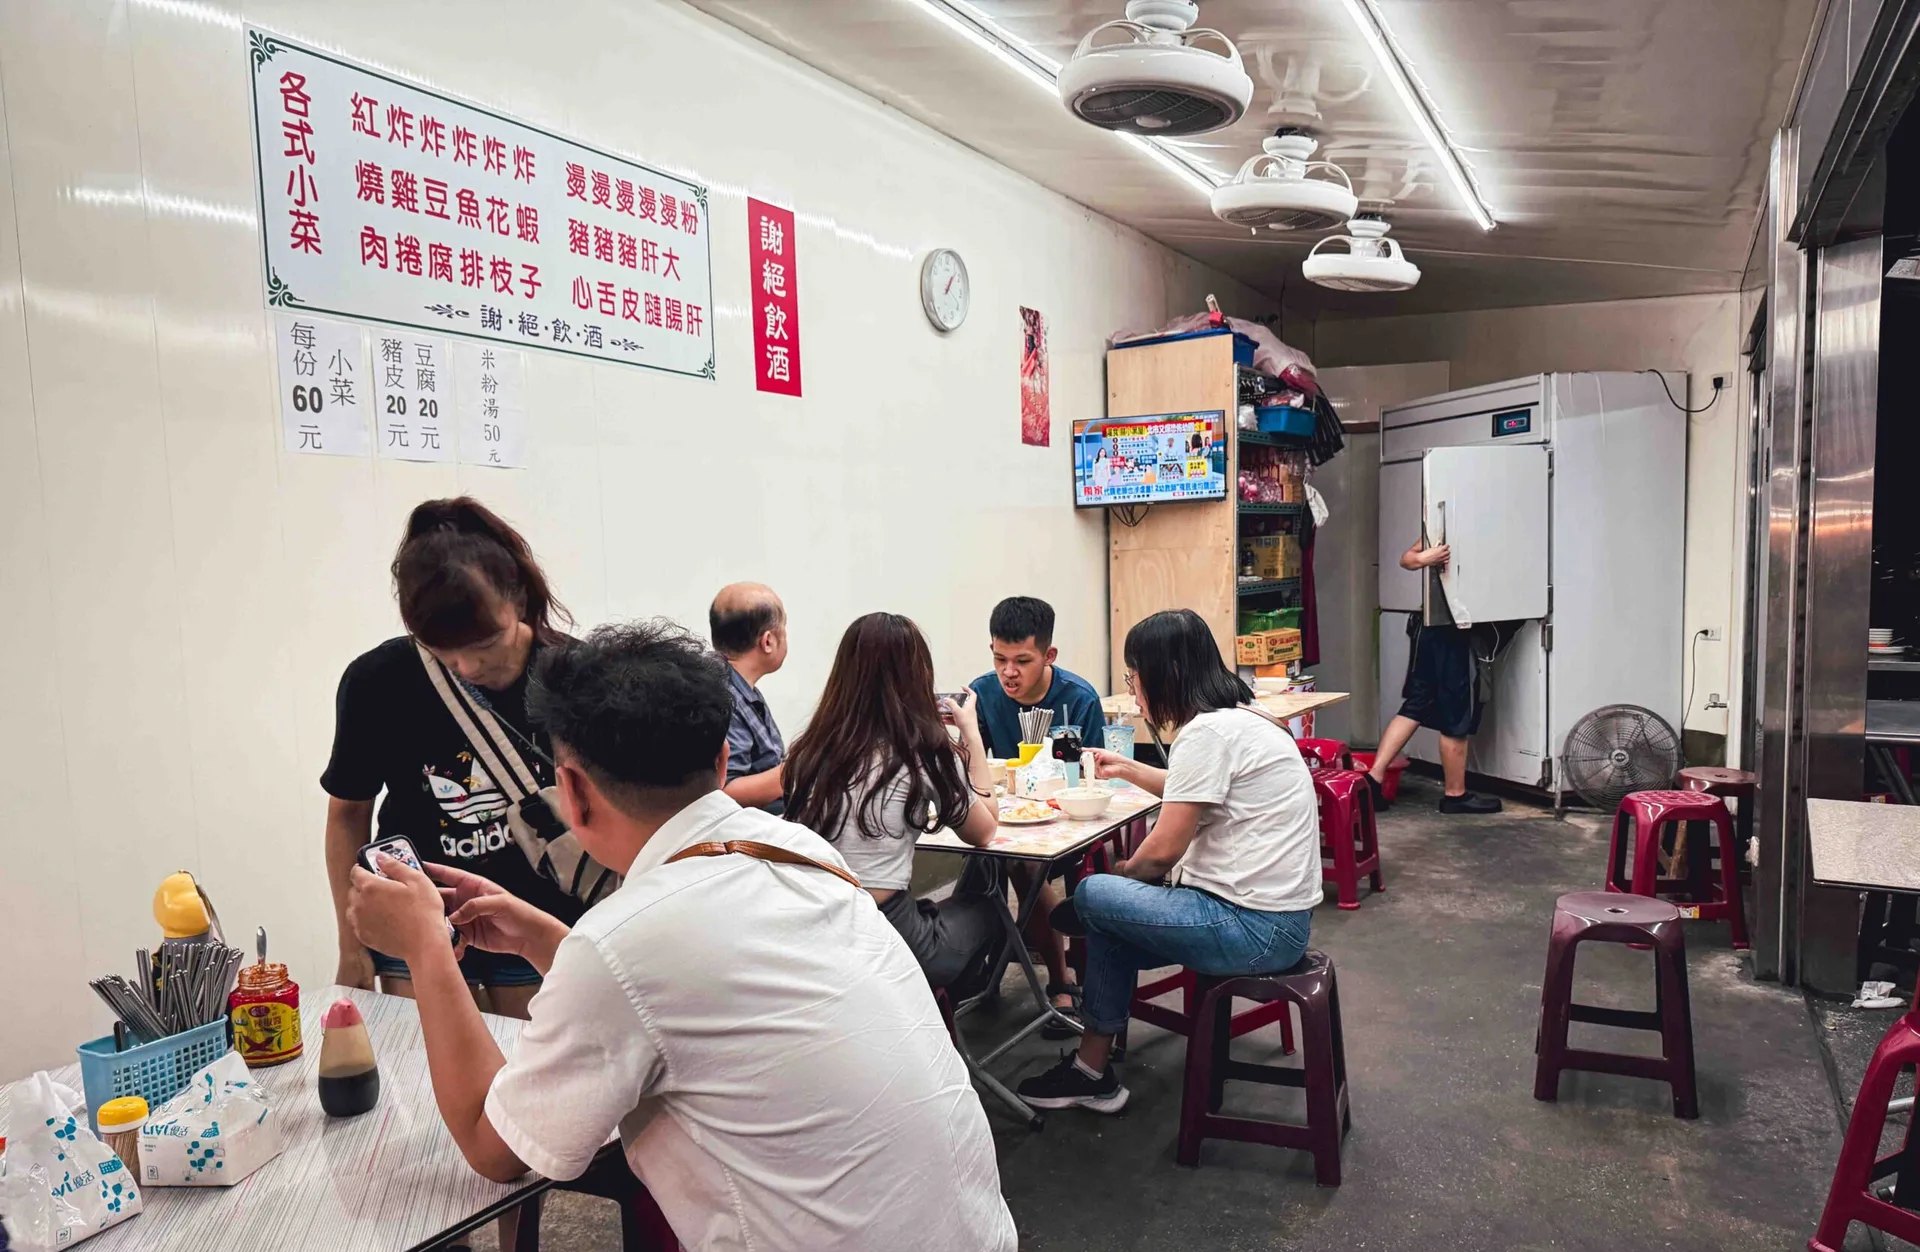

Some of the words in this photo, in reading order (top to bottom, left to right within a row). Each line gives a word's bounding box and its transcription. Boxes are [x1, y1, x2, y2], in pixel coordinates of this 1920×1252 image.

[280, 71, 322, 255] 各式小菜
[350, 91, 389, 270] 紅燒肉
[386, 103, 422, 276] 炸雞捲
[419, 114, 453, 283] 炸豆腐
[452, 124, 485, 289] 炸魚排
[483, 134, 514, 296] 炸花枝
[513, 144, 542, 299] 炸蝦子
[565, 160, 593, 311] 燙豬心
[591, 169, 616, 317] 燙豬舌
[615, 177, 641, 324] 燙豬皮
[659, 192, 683, 332] 燙大腸
[759, 215, 790, 383] 謝絕飲酒
[328, 348, 356, 406] 小菜
